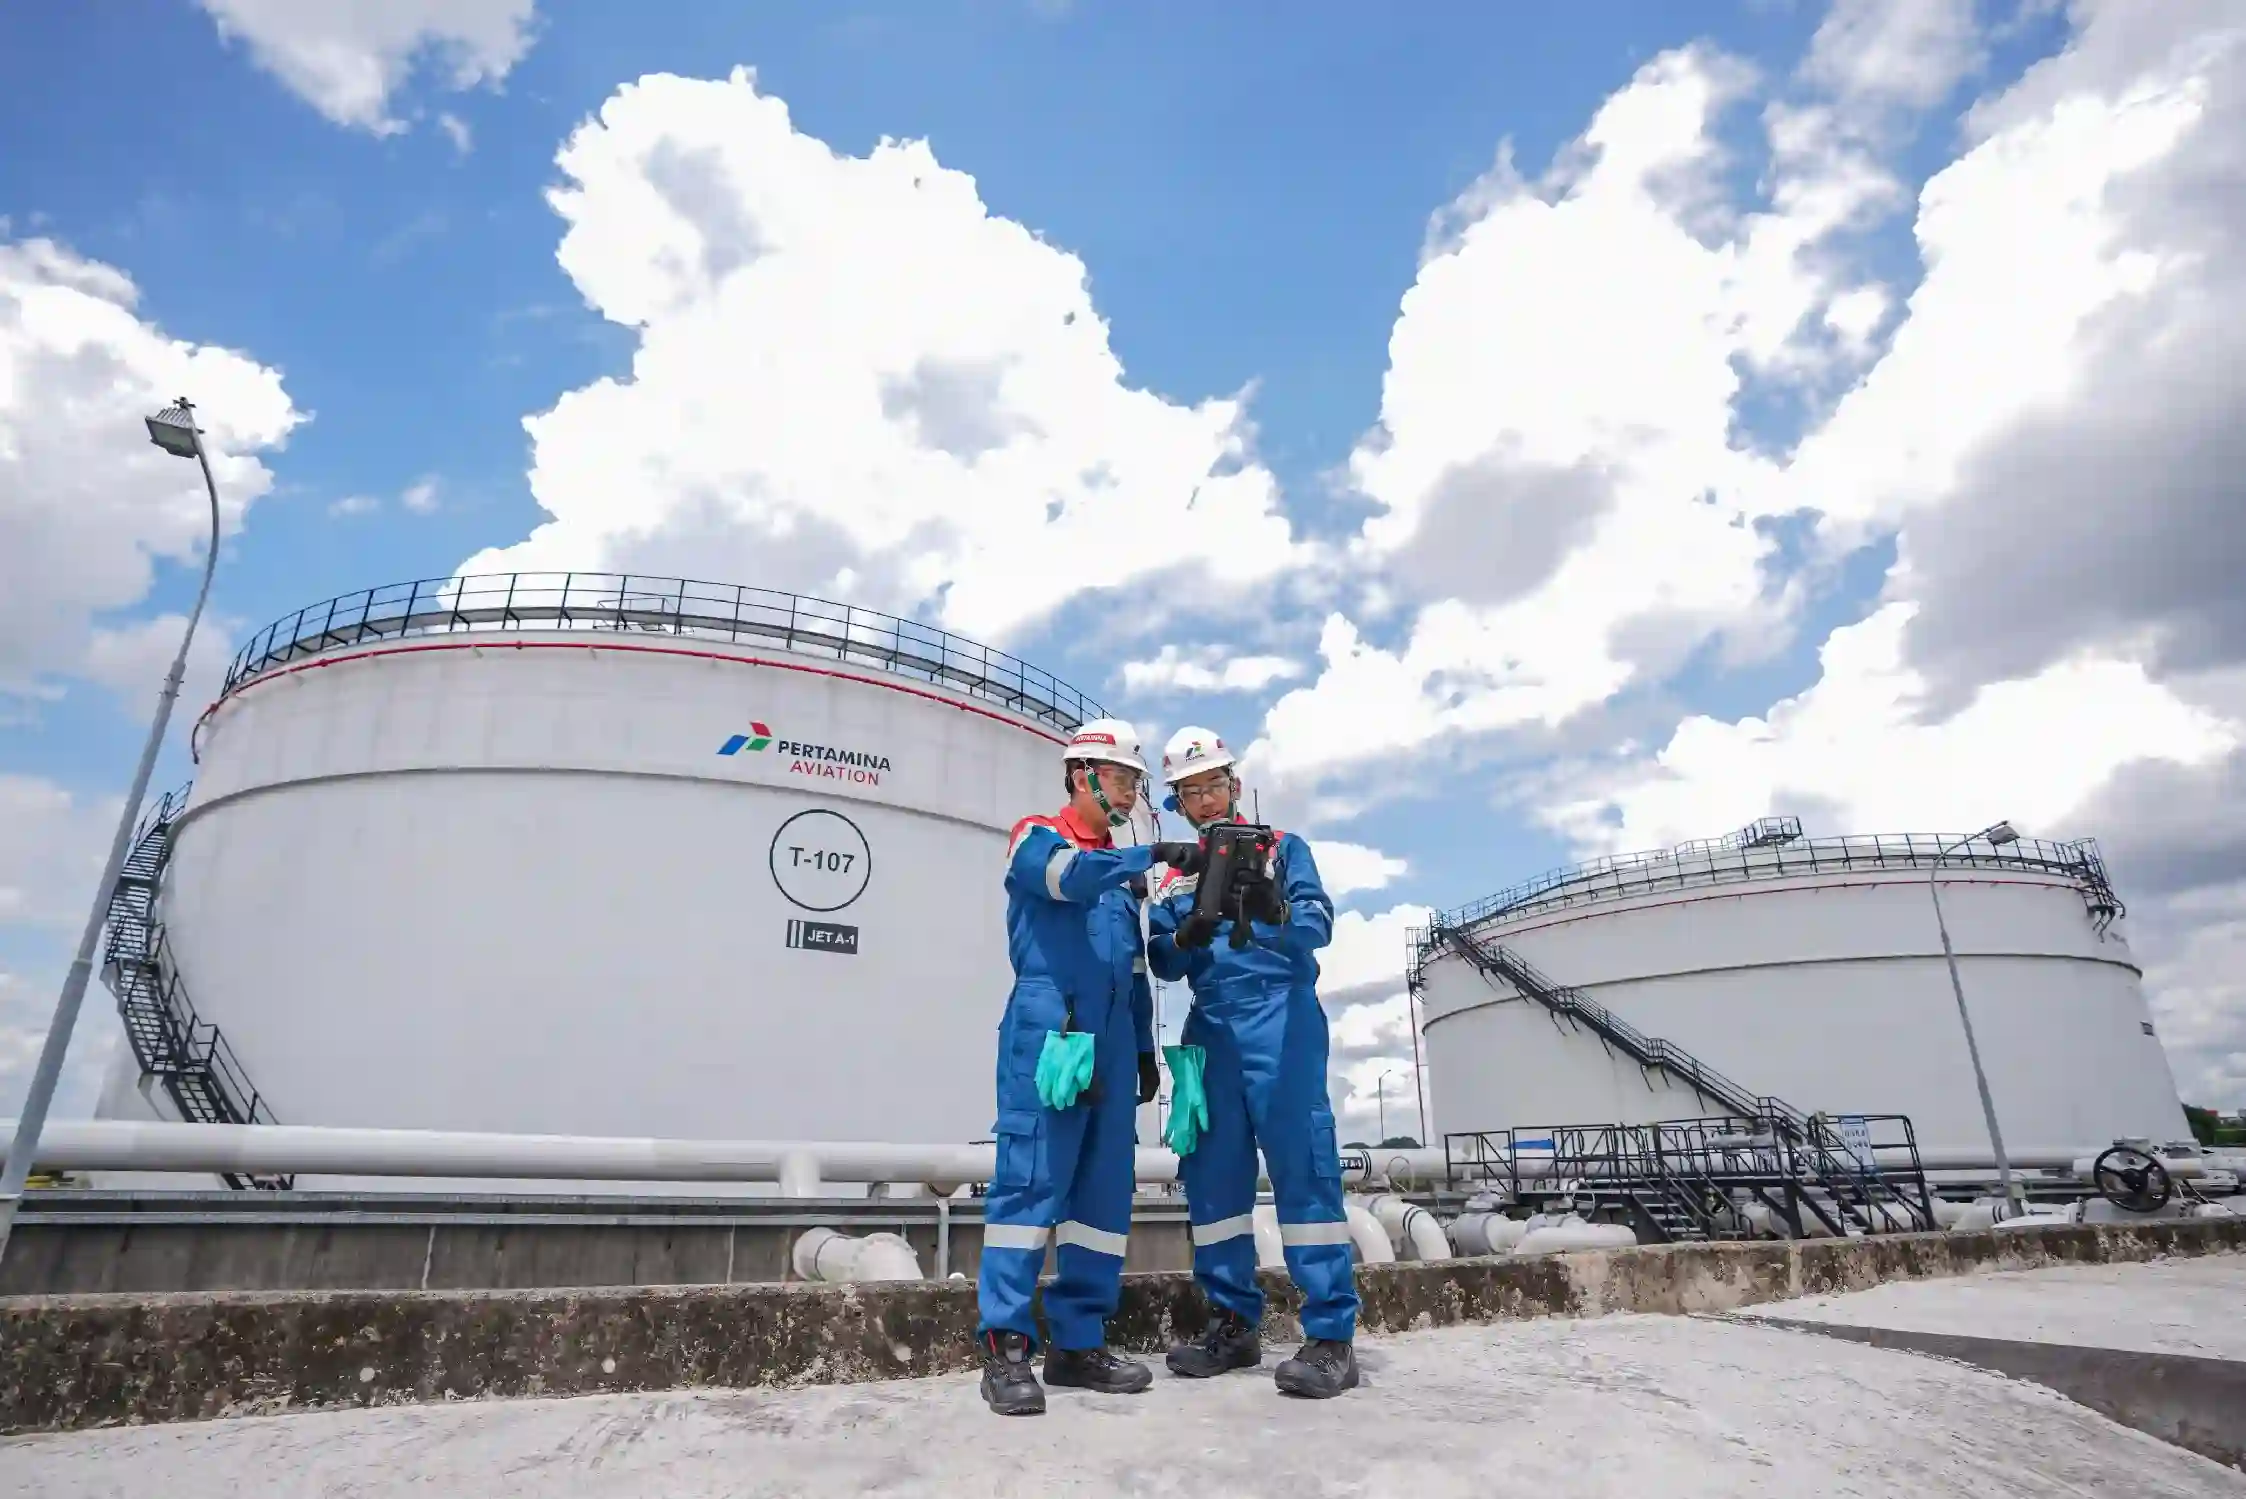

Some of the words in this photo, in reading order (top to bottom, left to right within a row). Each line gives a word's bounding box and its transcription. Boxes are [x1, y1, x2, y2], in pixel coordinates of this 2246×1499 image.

[778, 740, 891, 771] PERTAMINA
[790, 760, 880, 786] AVIATION
[789, 847, 855, 873] T-107
[808, 929, 834, 943] JET
[834, 933, 855, 945] A-1
